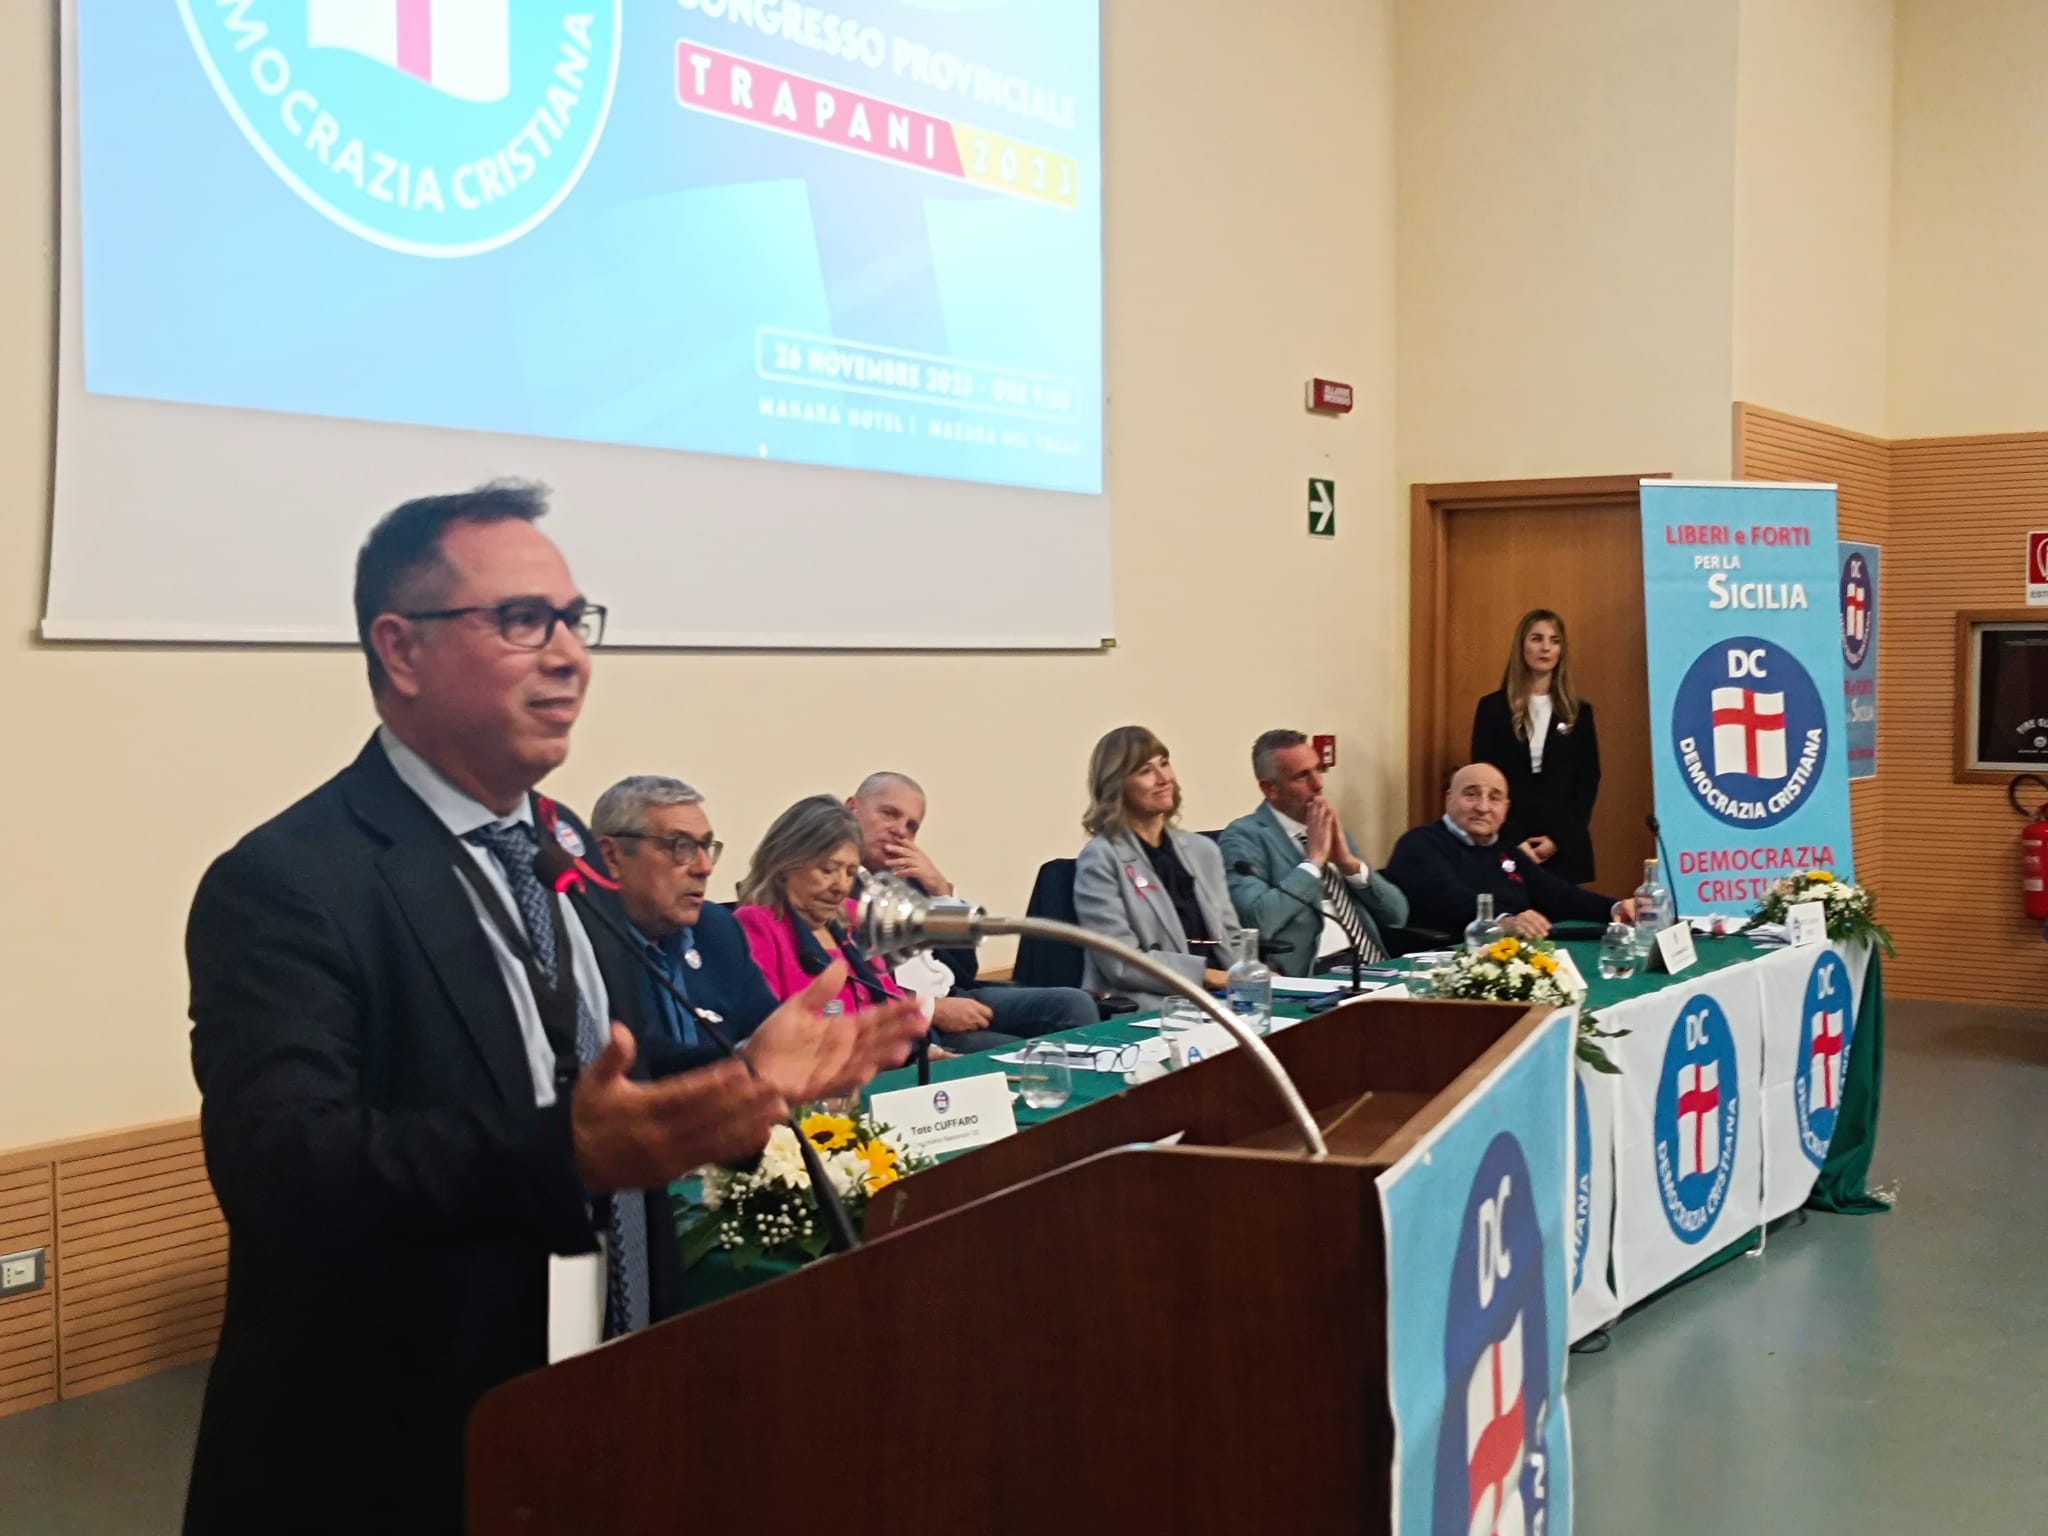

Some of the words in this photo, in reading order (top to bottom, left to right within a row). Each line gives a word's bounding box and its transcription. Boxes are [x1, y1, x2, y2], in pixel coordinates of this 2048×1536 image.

[676, 0, 885, 69] NGRESSO
[892, 36, 1076, 129] PROVINCIALE
[216, 0, 445, 213] MOCRAZIA
[451, 12, 595, 211] CRISTIANA
[689, 53, 935, 160] TRAPANI
[972, 138, 1072, 198] 2023
[807, 347, 921, 390] NOVEMBRE
[1665, 525, 1729, 545] LIBERI
[1734, 530, 1745, 545] e
[1751, 526, 1810, 546] FORTI
[1694, 555, 1721, 570] PER
[1723, 555, 1741, 570] LA
[1727, 649, 1767, 679] DC
[1679, 737, 1767, 819] DEMOCRAZIA
[1768, 728, 1823, 813] CRISTIANA
[1679, 845, 1835, 875] DEMOCRAZIA
[1697, 878, 1770, 903] CRISTI
[1817, 963, 1835, 1000] DC
[1685, 1008, 1710, 1052] DC
[934, 1115, 978, 1131] CUFFARO
[1657, 1140, 1708, 1232] DEMOCRAZIA
[1707, 1098, 1737, 1215] CRISTIANA
[1477, 1174, 1511, 1310] DC
